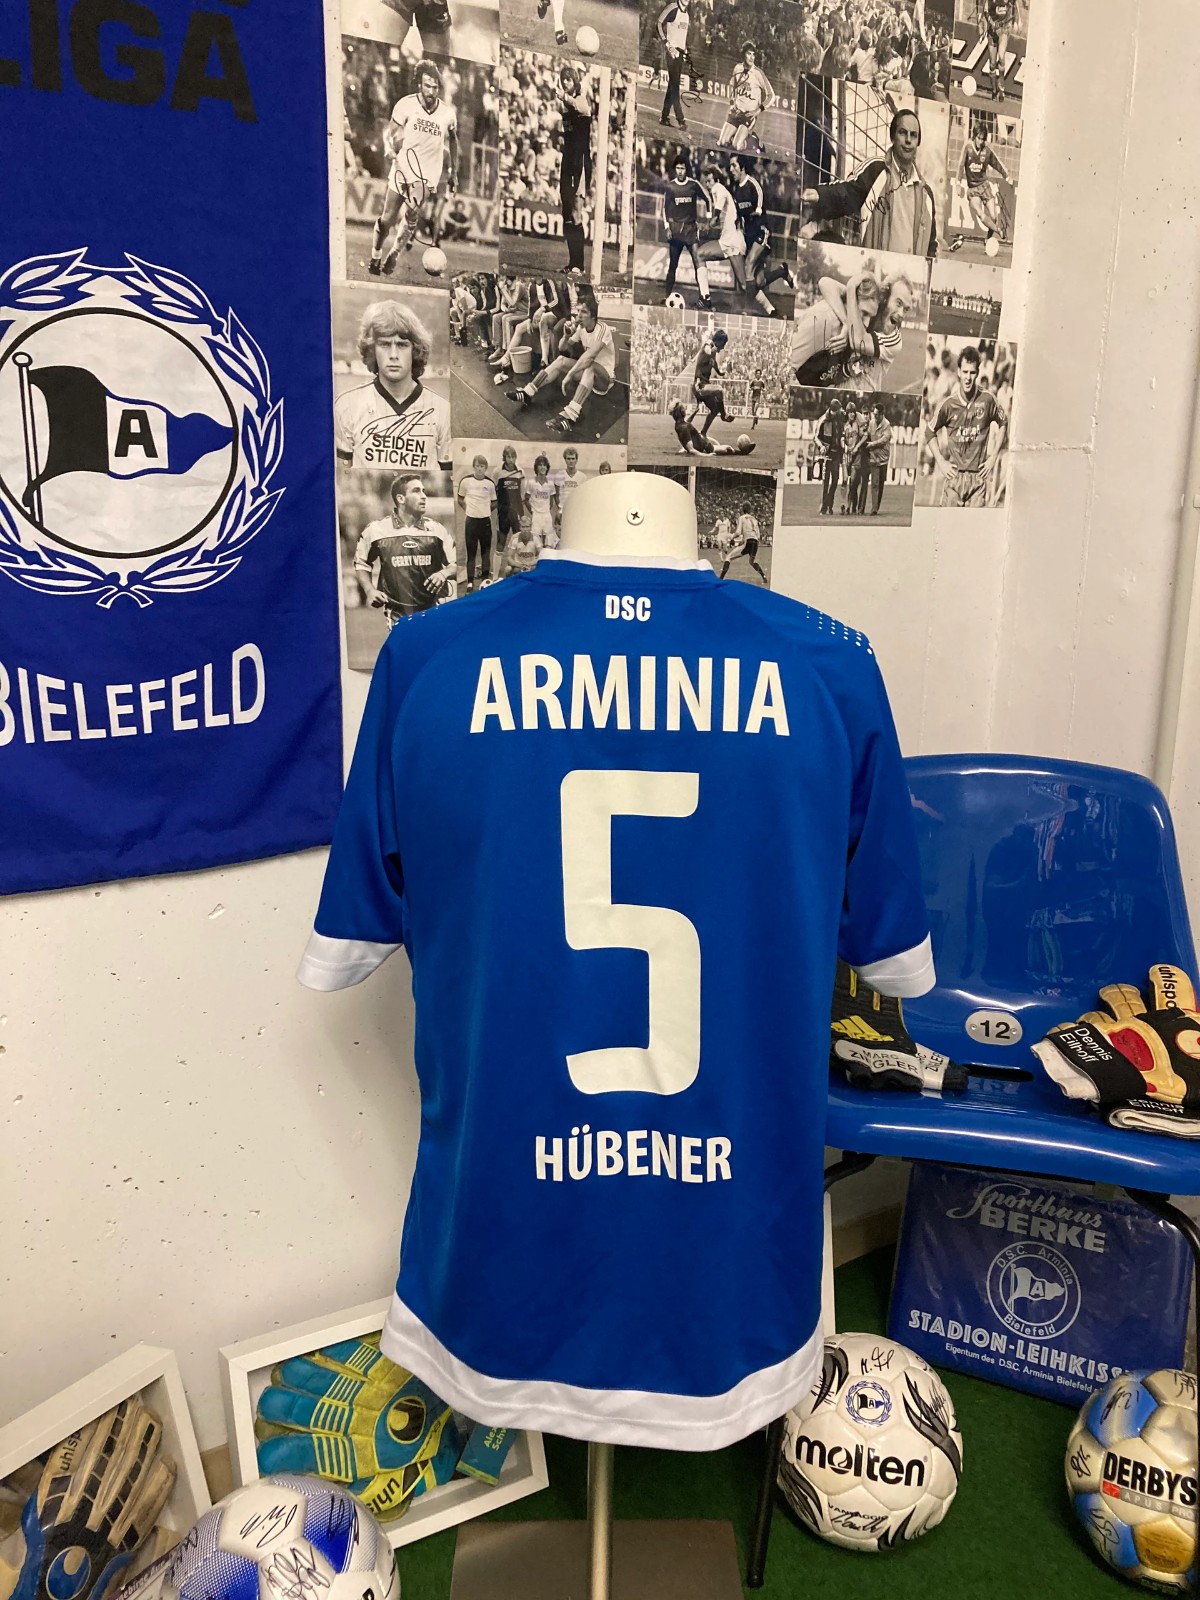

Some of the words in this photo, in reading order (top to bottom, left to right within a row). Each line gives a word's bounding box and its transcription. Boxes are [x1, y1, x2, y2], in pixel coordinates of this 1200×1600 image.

[413, 123, 442, 137] STICKER
[416, 117, 440, 130] SEIDEN
[114, 409, 159, 458] A
[371, 433, 426, 453] SEIDEN
[364, 447, 428, 468] STICKER
[391, 556, 412, 568] GERRY
[413, 555, 432, 566] WEBER
[605, 594, 652, 622] DSC
[469, 653, 790, 736] ARMINIA
[560, 769, 701, 1096] 5
[980, 1019, 1011, 1040] 12
[1074, 1027, 1113, 1061] Dennis
[863, 1049, 899, 1060] MARC
[1059, 1032, 1100, 1063] Eilhoff
[535, 1123, 733, 1184] HÜBENER
[946, 1183, 1103, 1228] Sporthaus
[979, 1205, 1107, 1254] BERKE
[1038, 1247, 1074, 1285] Arminia
[1029, 1280, 1045, 1297] A
[1003, 1313, 1056, 1336] Bielefeld
[945, 1343, 980, 1360] Eigentum
[981, 1353, 995, 1364] des
[1023, 1365, 1054, 1382] Arminia
[1056, 1375, 1093, 1393] Bielefeld
[868, 1399, 875, 1408] A
[795, 1435, 926, 1487] molten
[1103, 1451, 1197, 1506] DERBYS
